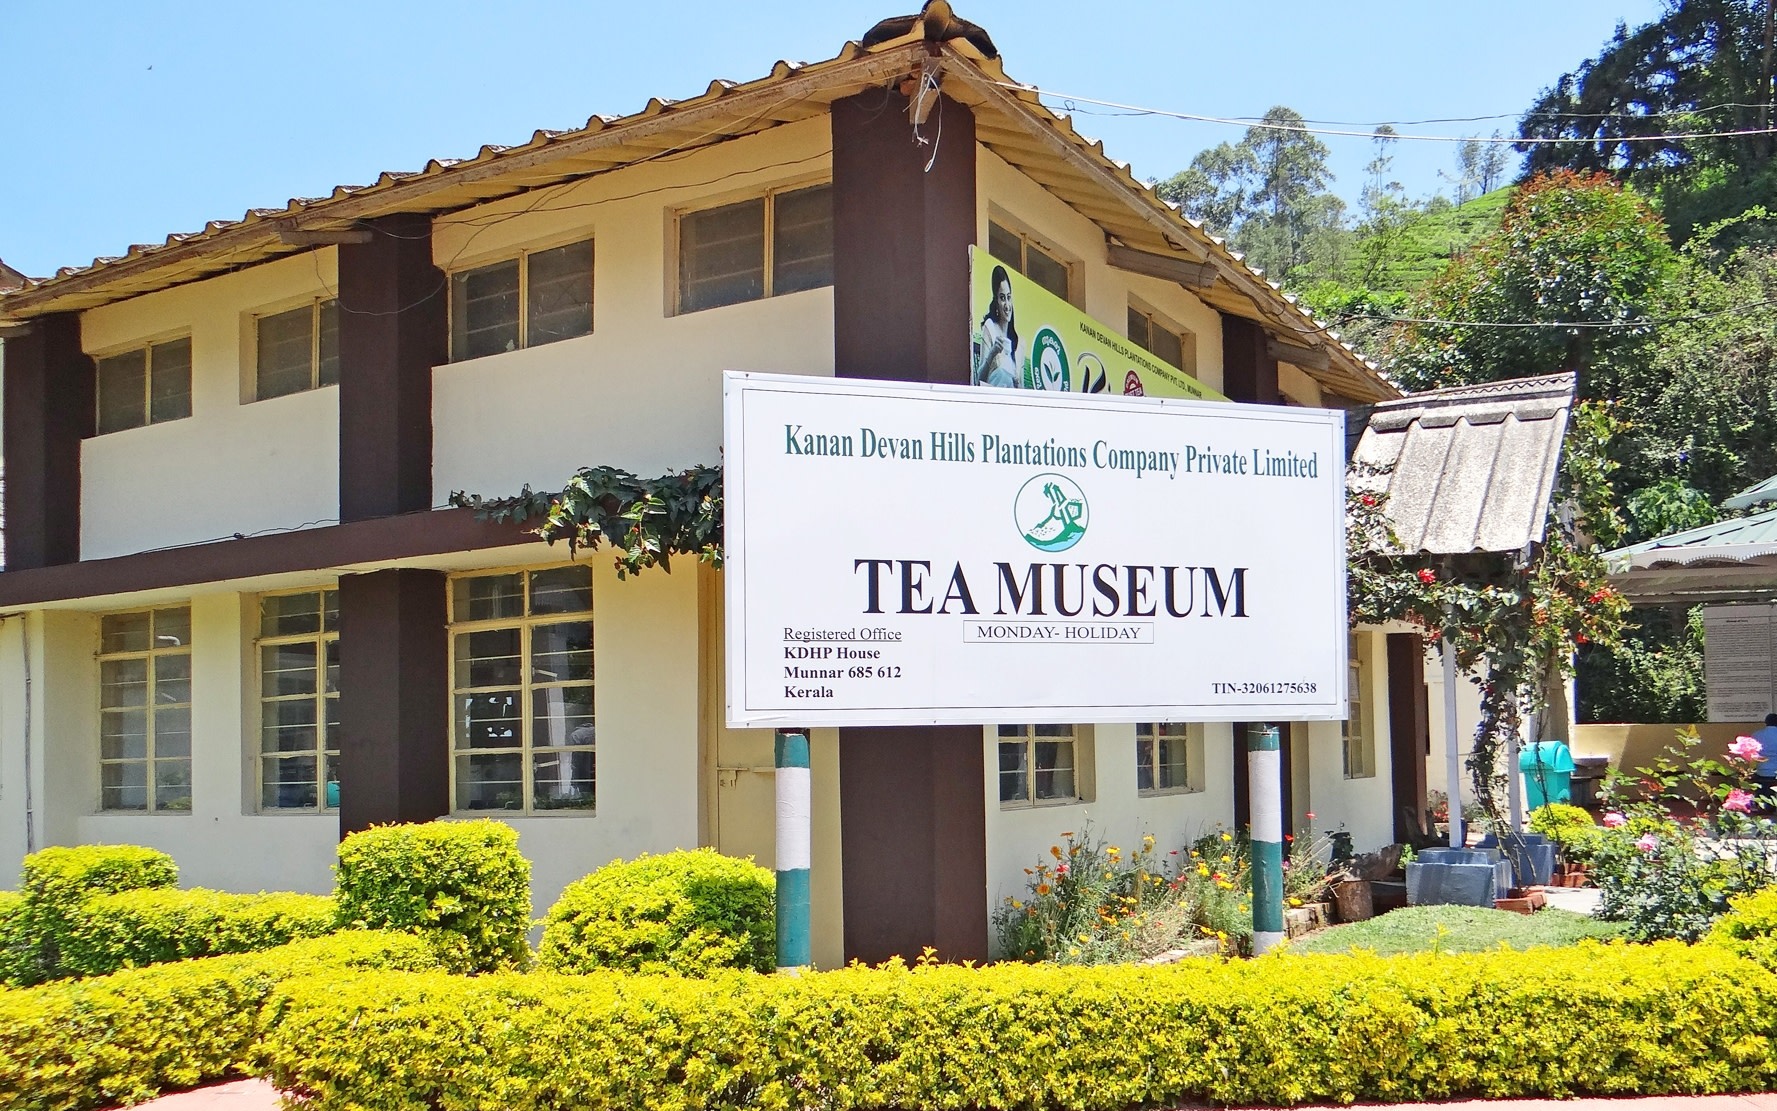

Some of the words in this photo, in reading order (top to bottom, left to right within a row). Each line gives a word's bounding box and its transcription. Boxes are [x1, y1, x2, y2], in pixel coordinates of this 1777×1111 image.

[1080, 321, 1096, 339] KANAN
[1096, 332, 1112, 349] DEVAN
[1112, 341, 1124, 355] HILLS
[1124, 348, 1151, 371] PLANTATIONS
[1152, 364, 1170, 382] COMPANY
[1187, 384, 1202, 399] MUNNAR
[784, 424, 854, 457] Kanan
[860, 428, 923, 460] Devan
[929, 431, 975, 463] Hills
[981, 434, 1087, 468] Plantations
[1092, 439, 1180, 480] Company
[1185, 445, 1248, 475] Private
[1252, 449, 1319, 479] Limited
[854, 558, 980, 615] TEA
[993, 561, 1250, 618] MUSEUM
[783, 627, 856, 642] Registered
[860, 627, 902, 640] Office
[977, 625, 1060, 639] MONDAY-
[1065, 626, 1141, 640] HOLIDAY
[783, 647, 833, 660] KDHP
[837, 647, 881, 660] House
[783, 666, 845, 679] Munnar
[848, 666, 873, 679] 685
[877, 666, 902, 679] 612
[783, 685, 834, 698] Kerala
[1211, 682, 1318, 694] TIN-32061275638
